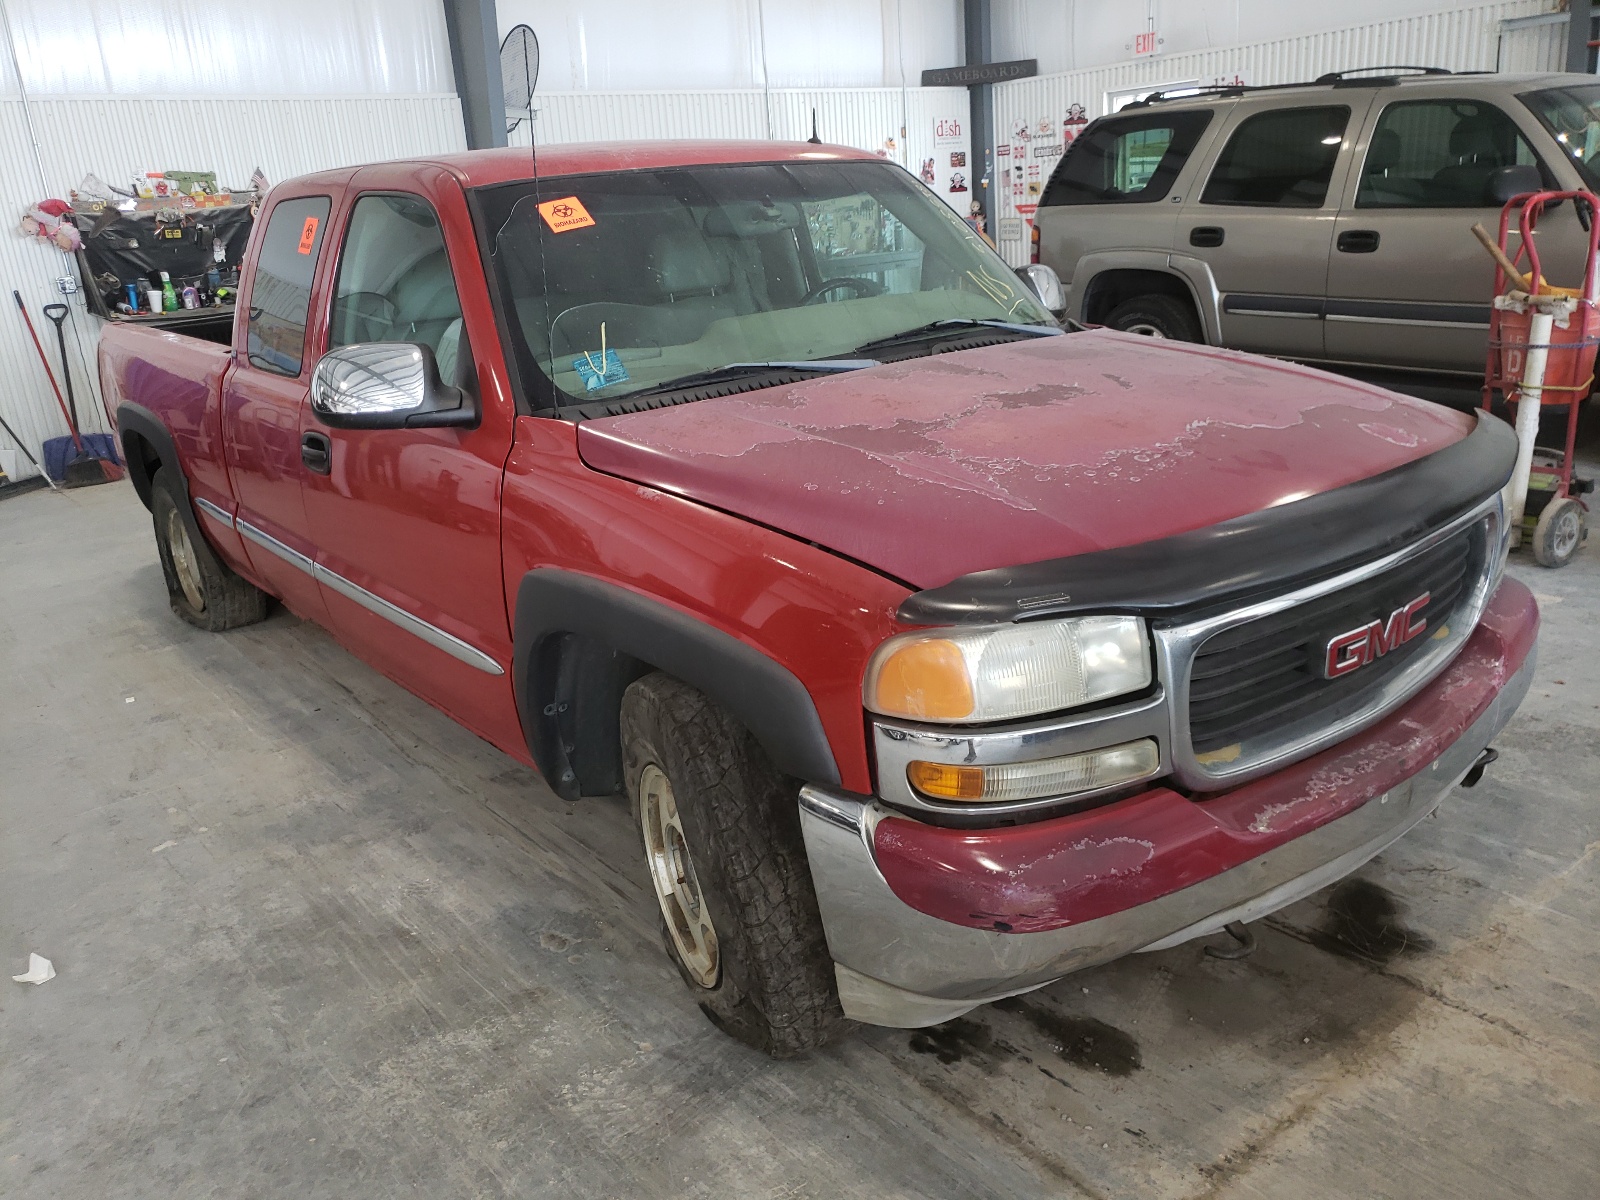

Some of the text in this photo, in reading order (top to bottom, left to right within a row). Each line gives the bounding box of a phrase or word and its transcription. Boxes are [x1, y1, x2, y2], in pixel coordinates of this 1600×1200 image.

[1135, 32, 1155, 54] EXIT
[553, 216, 588, 229] BIOHAZARD
[1324, 590, 1431, 680] GMC
